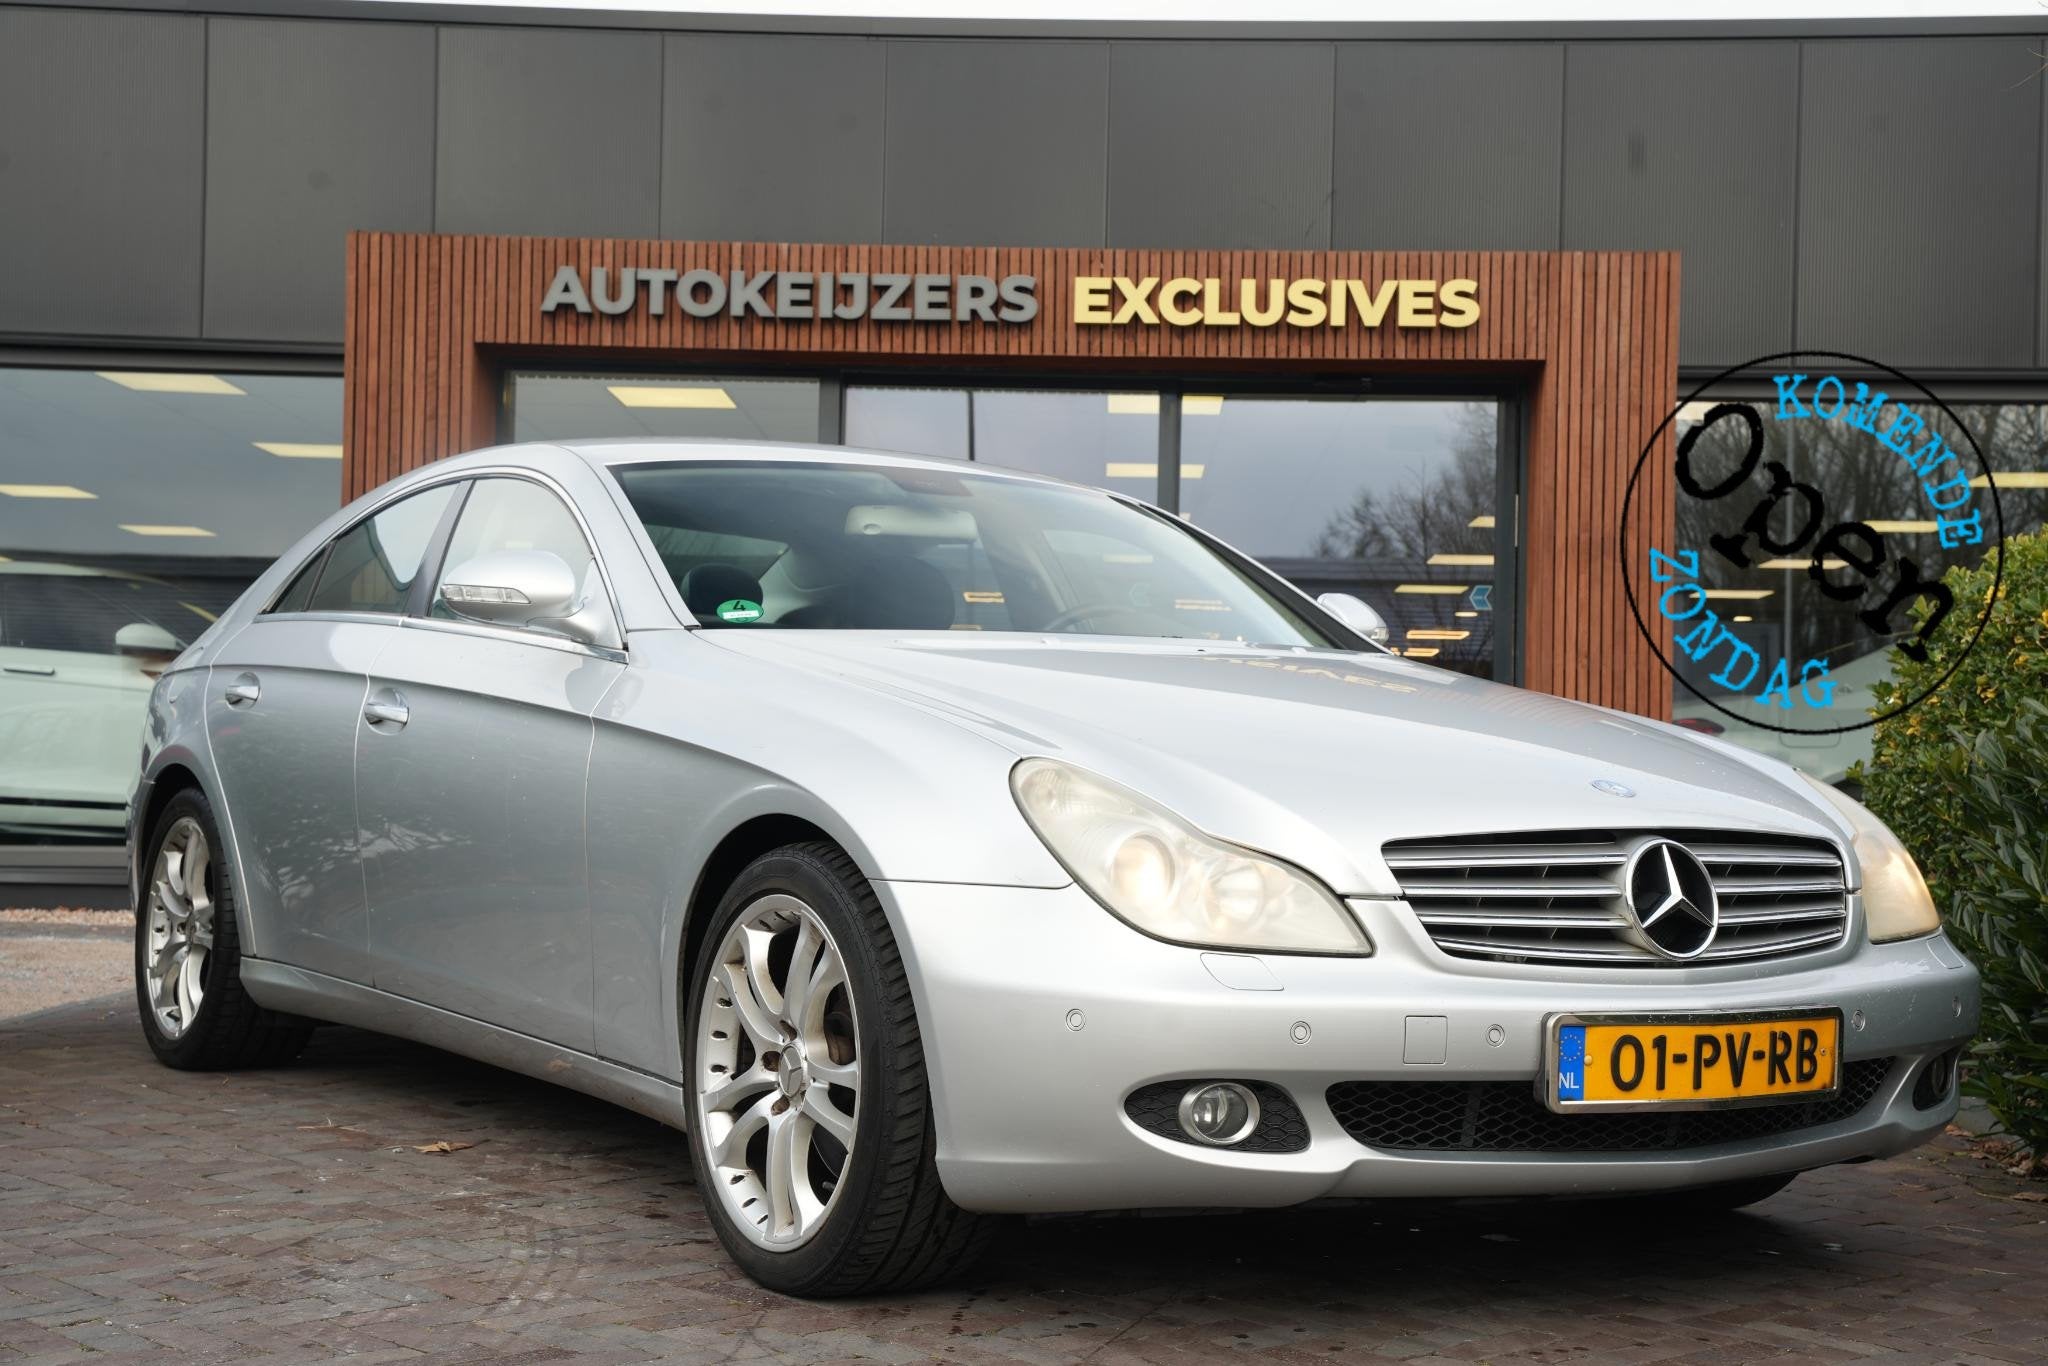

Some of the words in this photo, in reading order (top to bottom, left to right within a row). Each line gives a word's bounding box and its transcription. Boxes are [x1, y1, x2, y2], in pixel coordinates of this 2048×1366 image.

[540, 265, 1039, 323] AUTOKEIJZERS
[1073, 276, 1481, 329] EXCLUSIVES
[732, 600, 746, 611] 4
[1558, 1071, 1580, 1089] NL
[1610, 1028, 1818, 1092] 01-PV-RB
